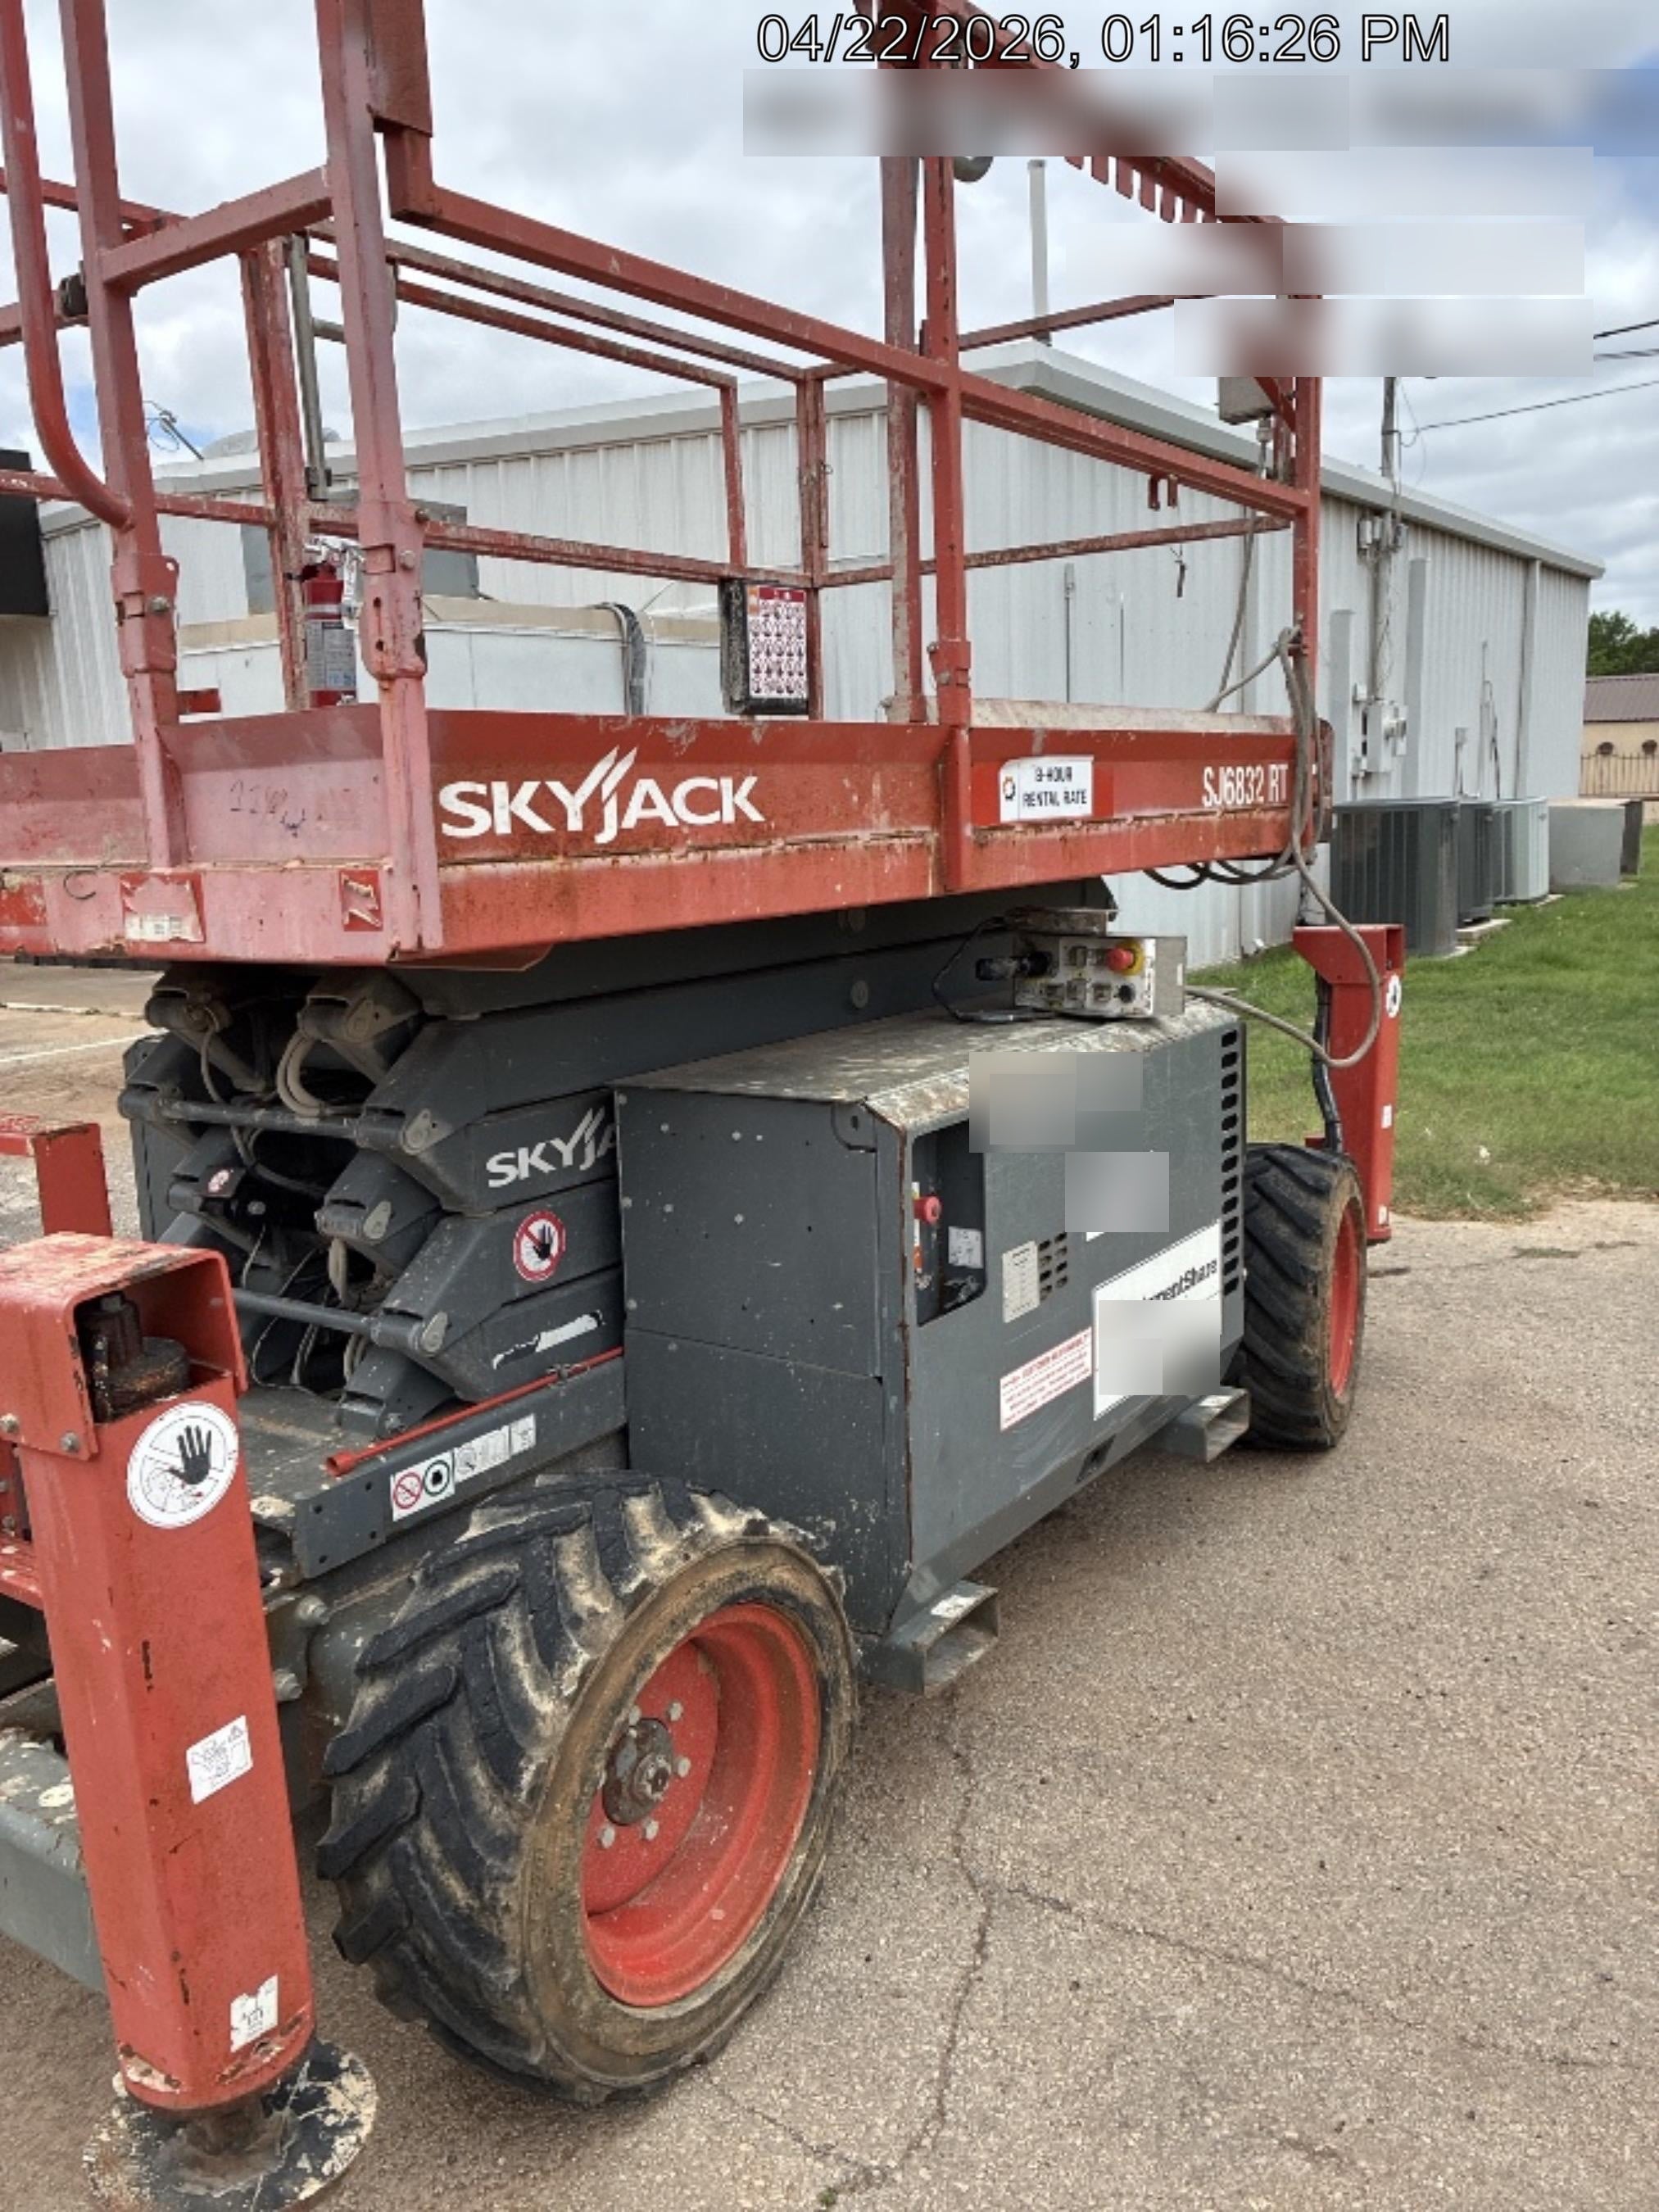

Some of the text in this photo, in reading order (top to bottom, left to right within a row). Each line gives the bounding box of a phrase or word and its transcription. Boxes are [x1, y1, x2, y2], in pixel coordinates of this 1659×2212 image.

[438, 745, 766, 844] SKYJACK
[1022, 789, 1087, 807] RENTAL RATE
[1202, 764, 1289, 807] SJ6832 RT
